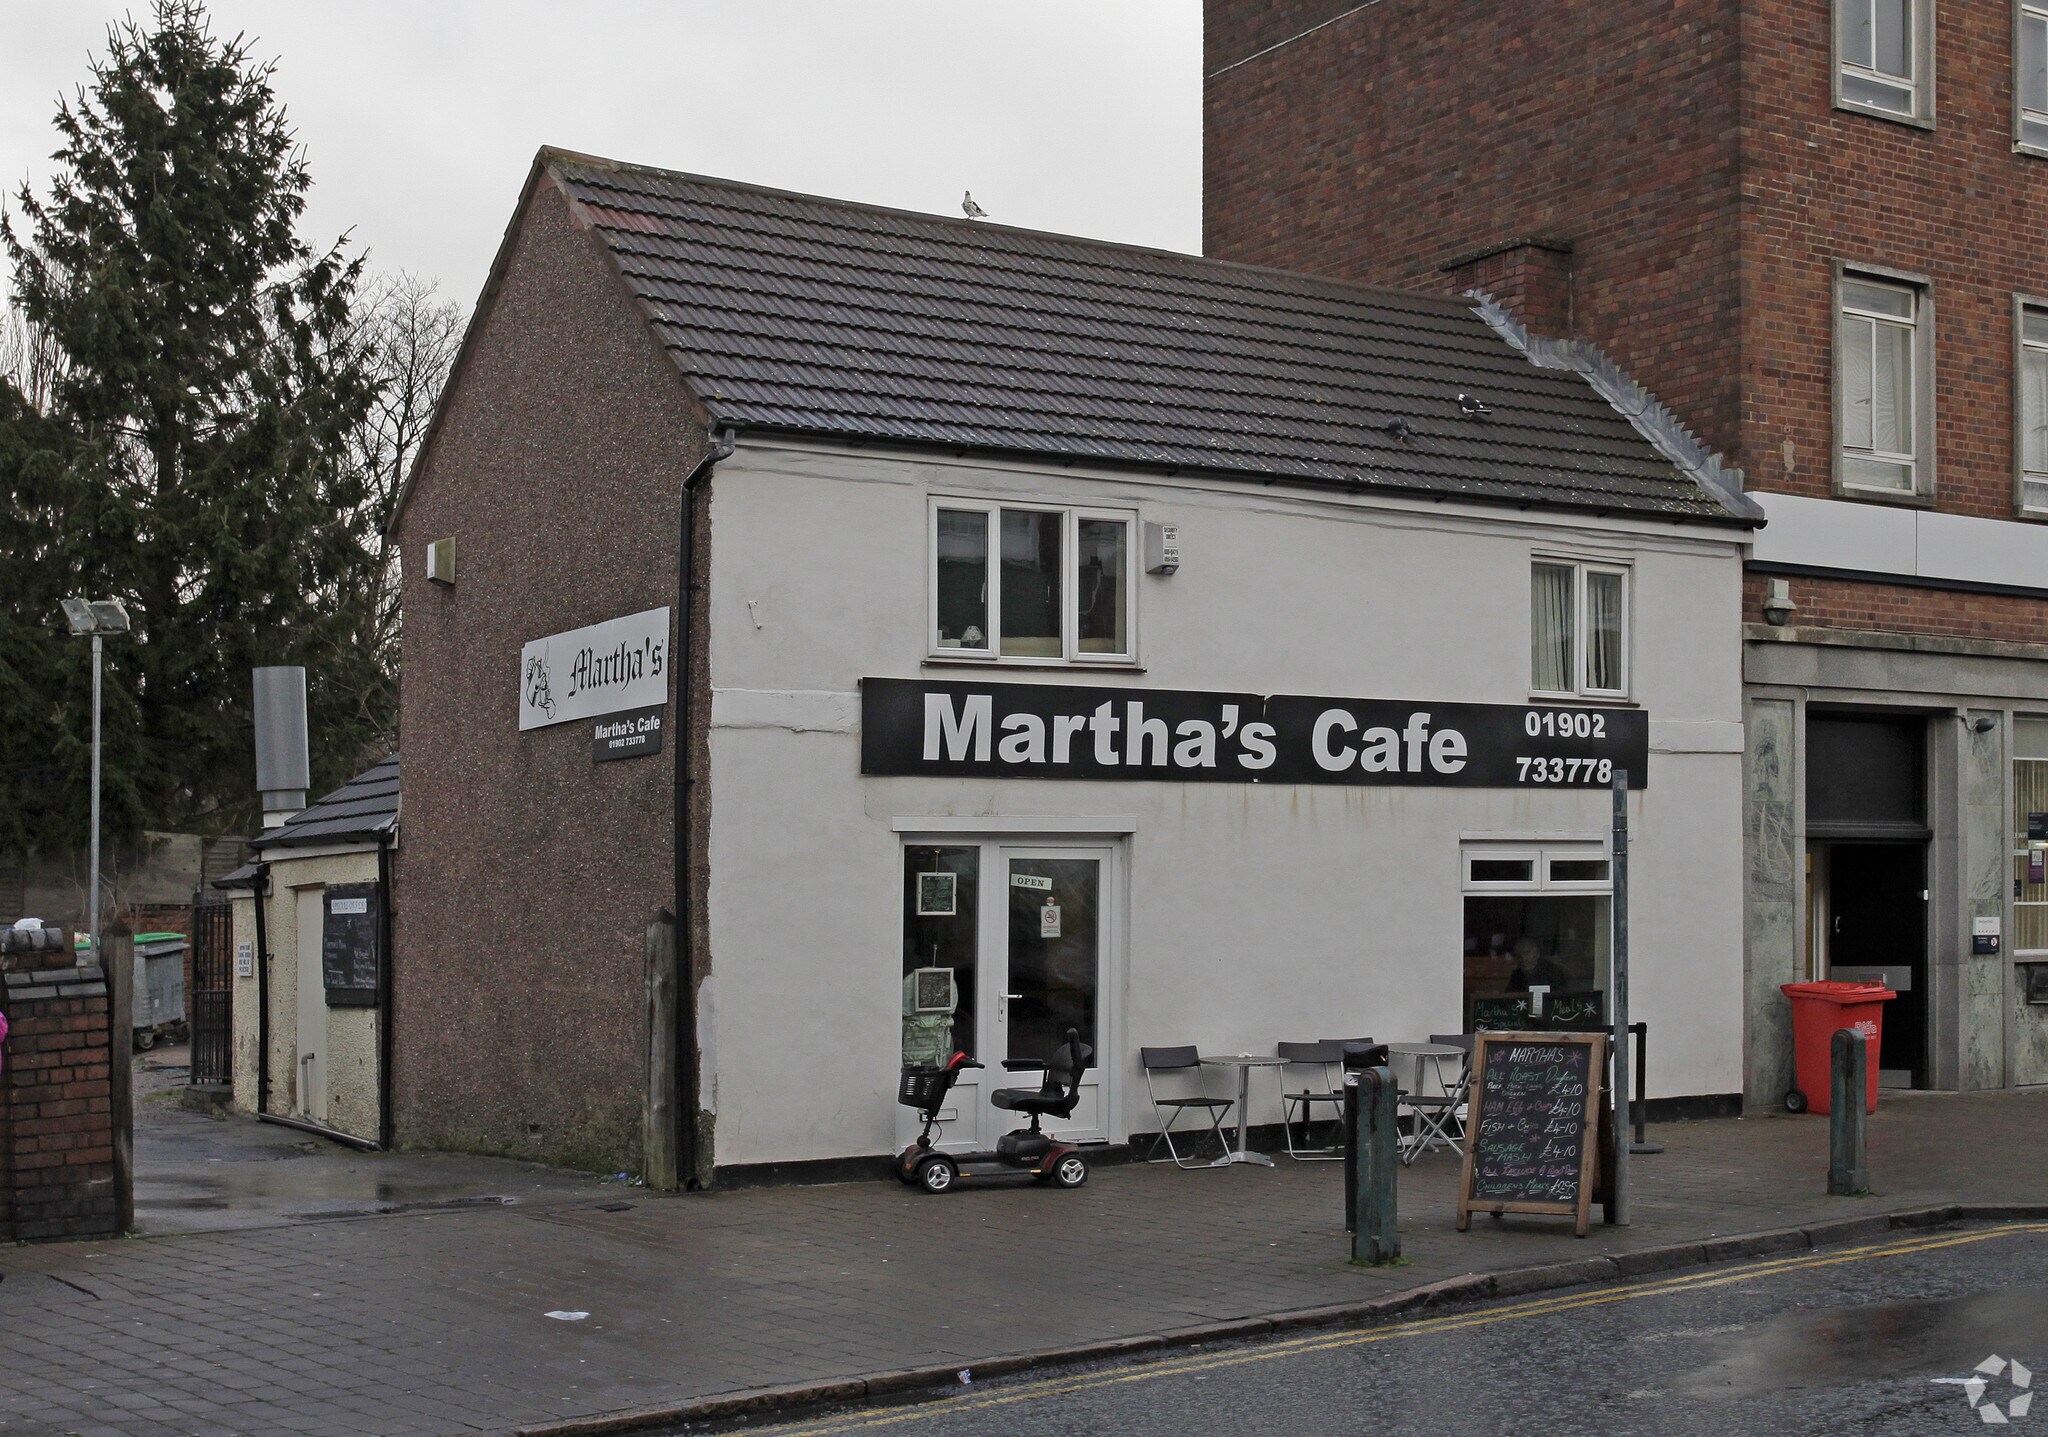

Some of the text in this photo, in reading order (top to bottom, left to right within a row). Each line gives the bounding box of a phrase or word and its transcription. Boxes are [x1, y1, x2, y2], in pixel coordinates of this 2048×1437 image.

[568, 636, 664, 699] Martha's
[595, 715, 661, 740] Martha's Cafe
[922, 692, 1468, 774] Martha's Cafe
[1525, 711, 1606, 738] 01902
[608, 735, 646, 749] 01902 733778
[1516, 757, 1612, 783] 733778
[1017, 876, 1045, 887] OPEN
[1483, 1100, 1505, 1113] HAM
[1505, 1100, 1524, 1114] EGG
[1480, 1139, 1525, 1153] SAUSAGE
[1497, 1153, 1532, 1162] MASH
